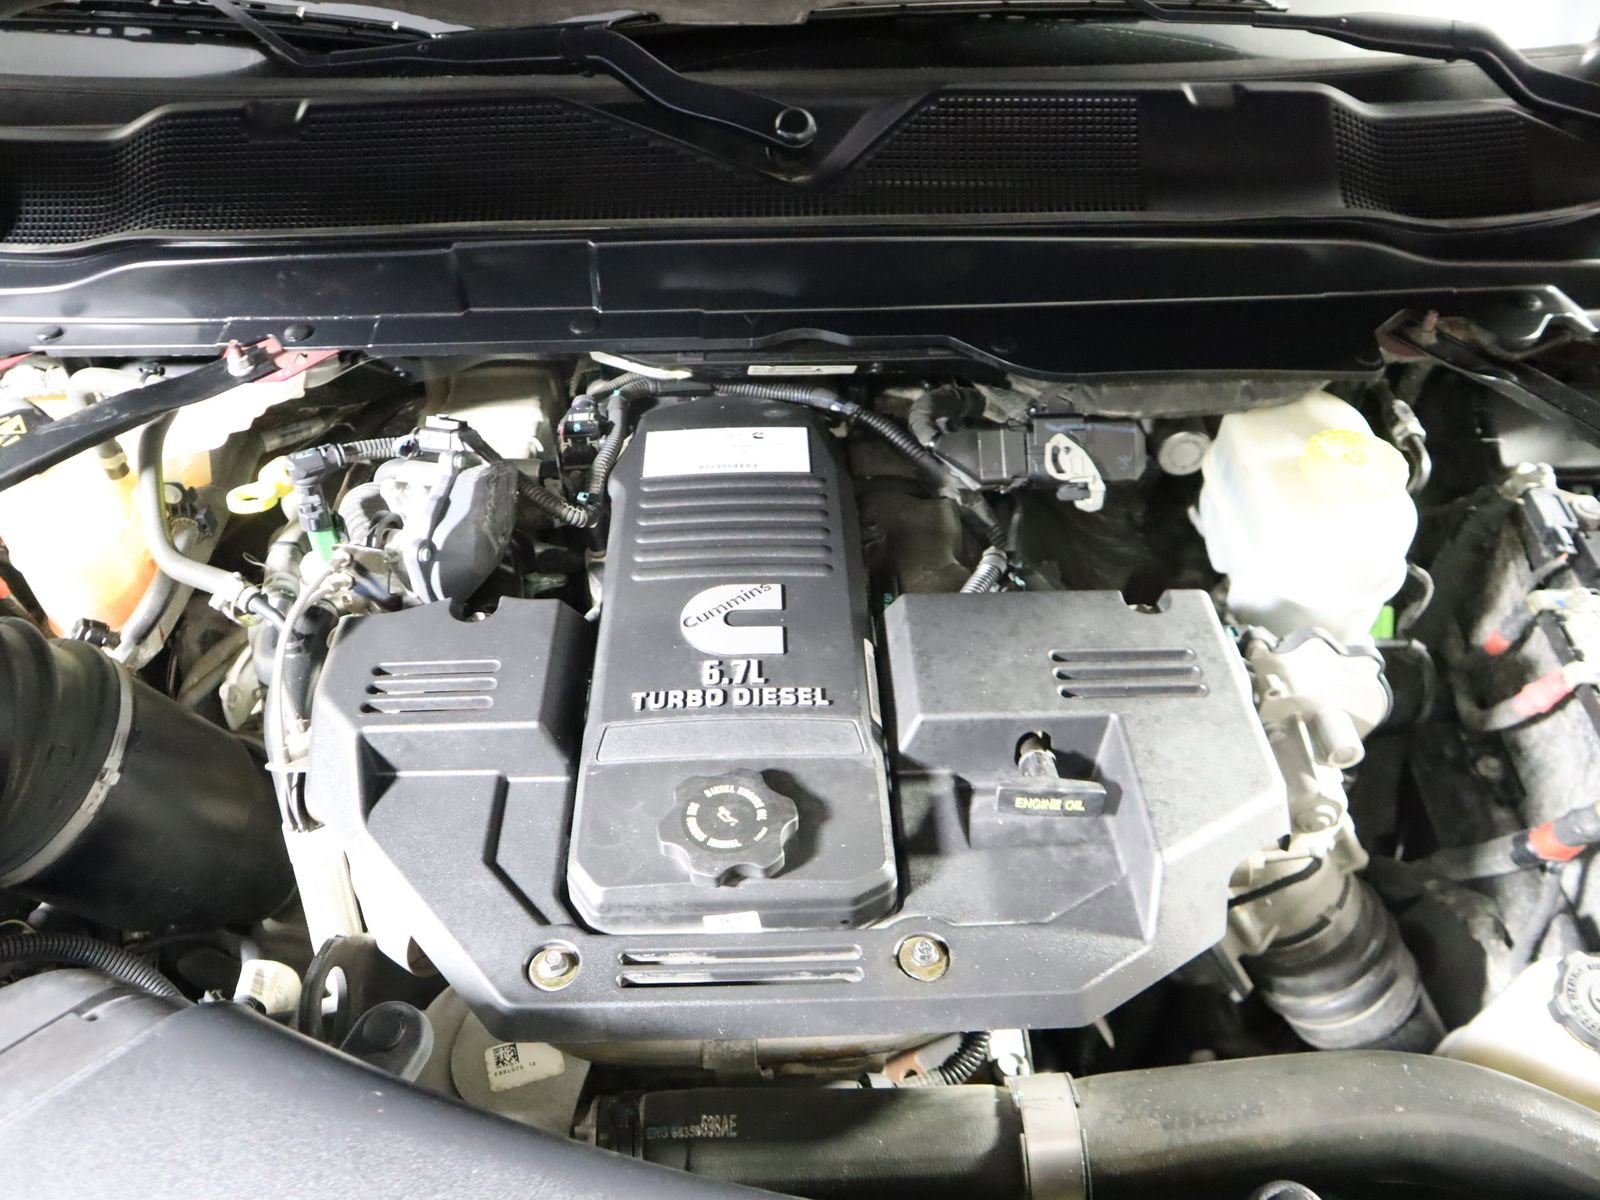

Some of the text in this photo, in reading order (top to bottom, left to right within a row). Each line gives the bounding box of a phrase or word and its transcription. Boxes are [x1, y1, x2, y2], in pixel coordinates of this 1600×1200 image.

[683, 583, 772, 628] Cummins
[702, 659, 767, 686] 6.7L
[631, 687, 831, 711] TURBO DIESEL
[1014, 796, 1086, 812] ENGINE OIL
